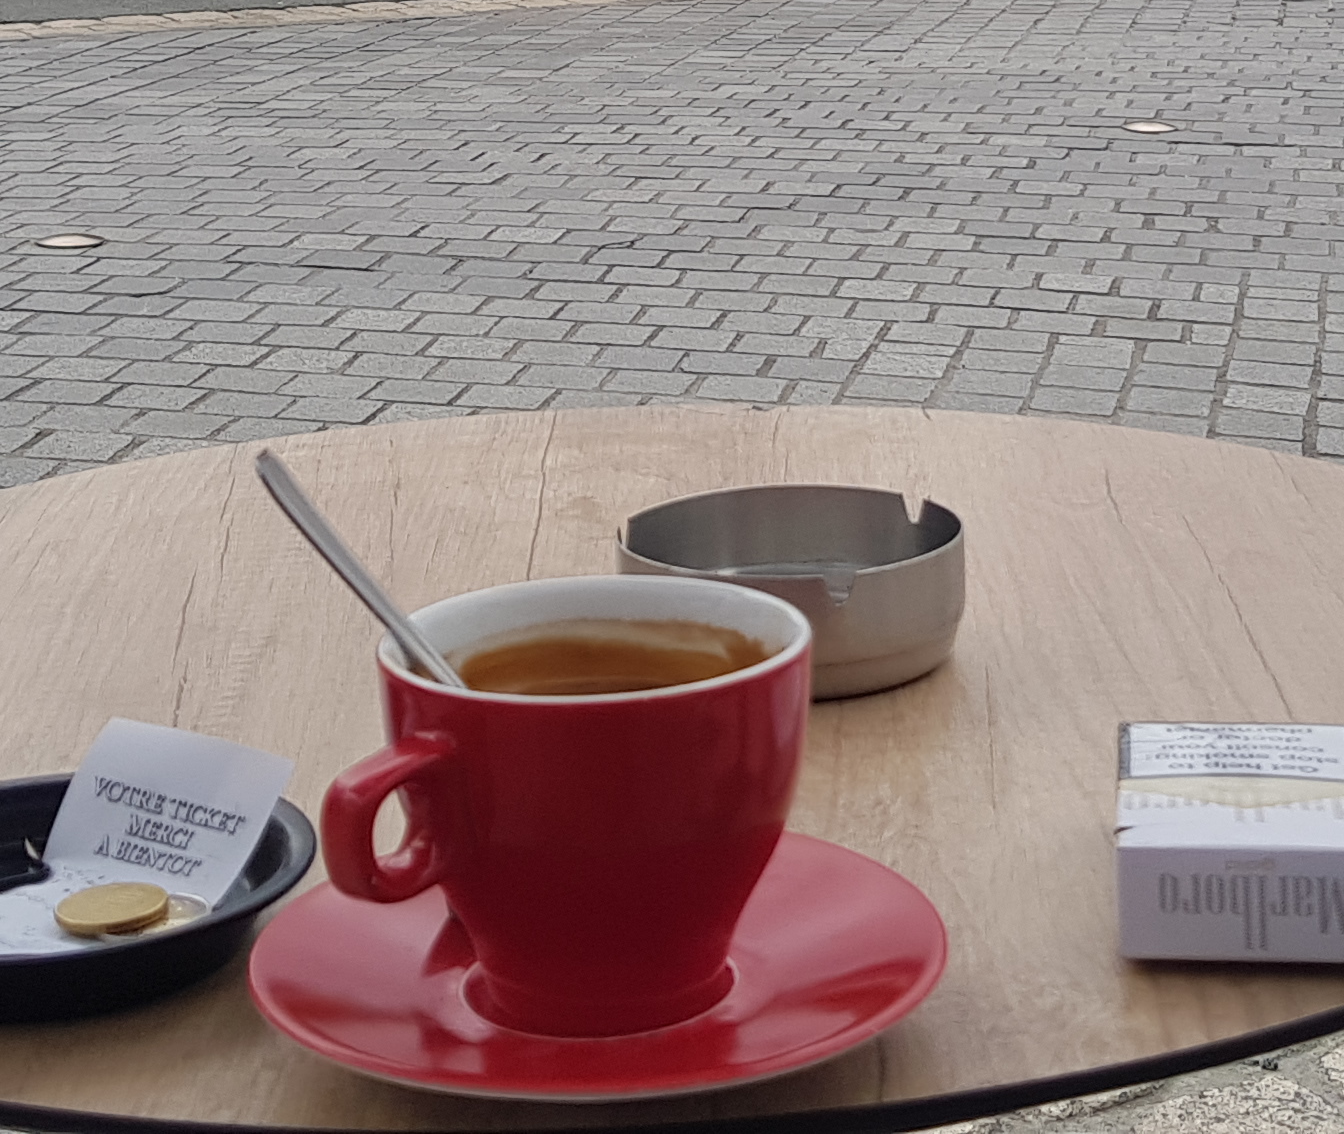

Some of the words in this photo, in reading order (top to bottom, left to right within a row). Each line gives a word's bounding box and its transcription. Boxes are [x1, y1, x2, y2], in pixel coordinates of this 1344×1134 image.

[1168, 762, 1194, 770] to
[1203, 760, 1262, 770] help
[1279, 753, 1338, 764] stop
[95, 776, 167, 815] VOTRE
[169, 798, 246, 835] TICKET
[125, 814, 194, 850] MERCI
[94, 834, 110, 857] A
[111, 839, 202, 877] BIENTOT
